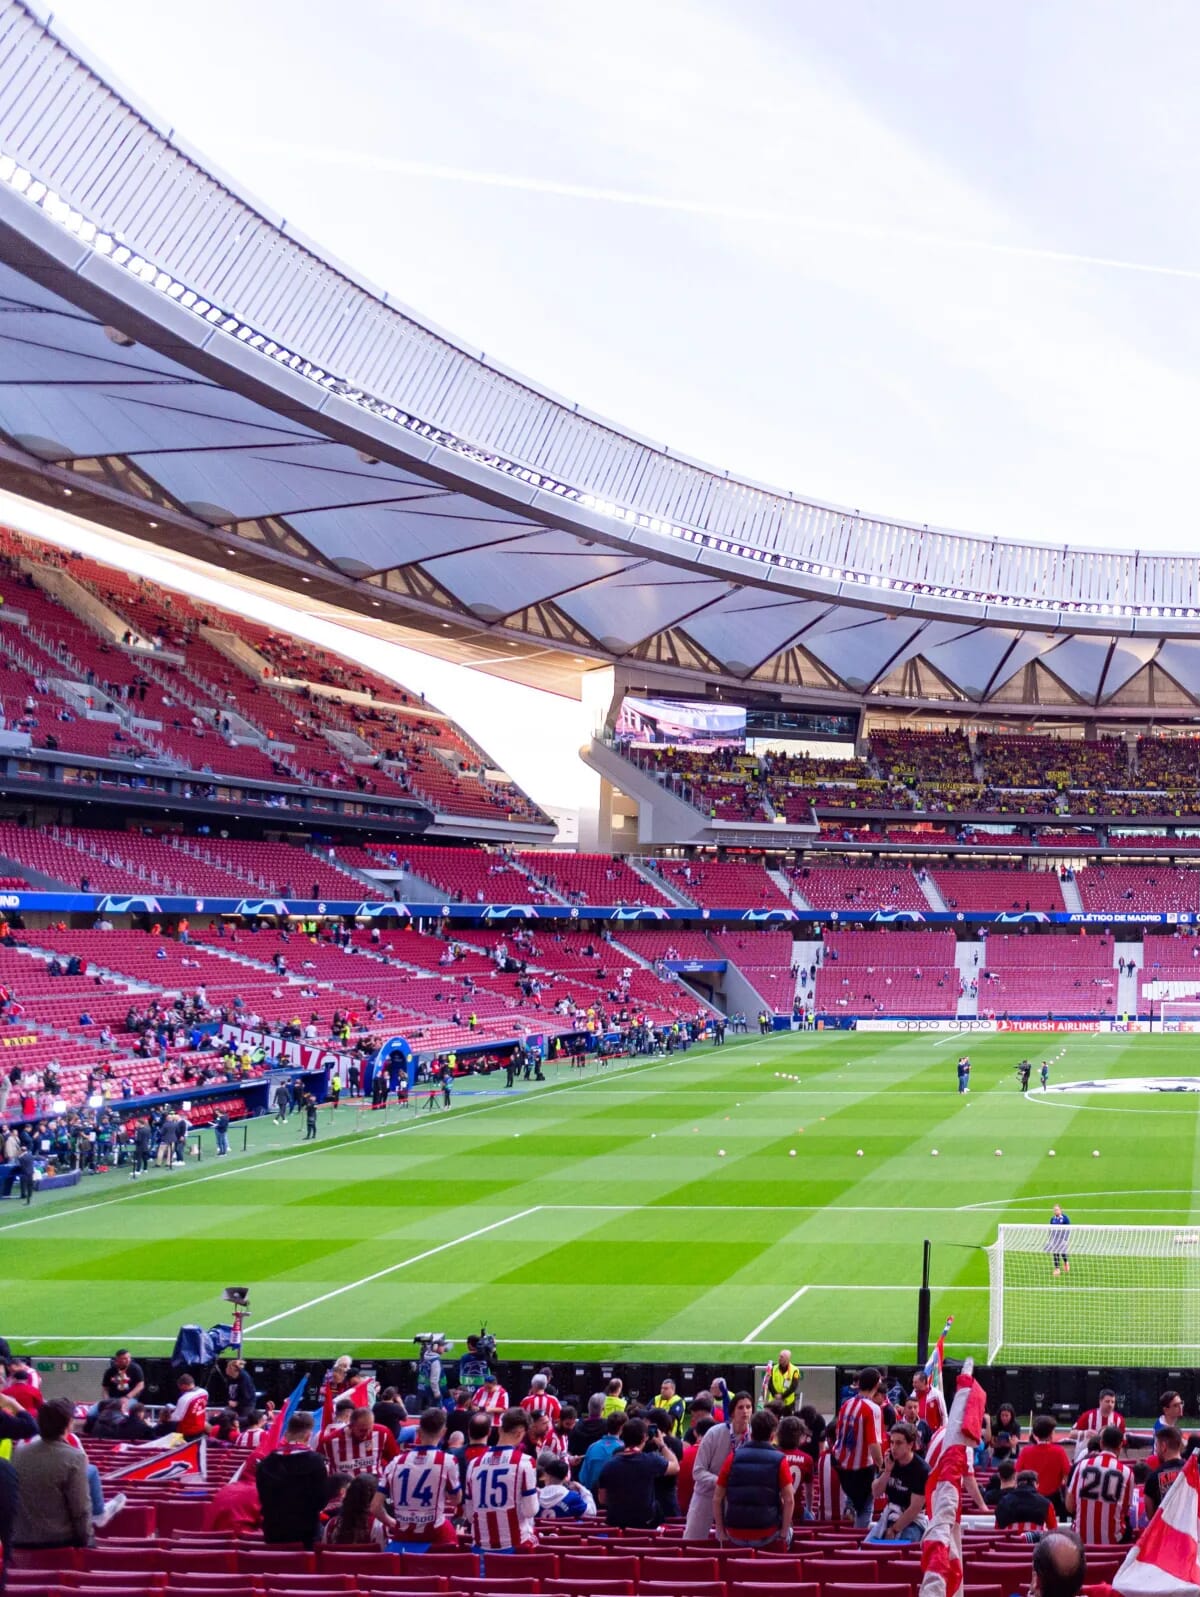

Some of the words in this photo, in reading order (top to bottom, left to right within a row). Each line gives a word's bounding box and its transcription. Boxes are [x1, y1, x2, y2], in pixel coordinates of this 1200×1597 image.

[1070, 912, 1113, 922] ATLÉTICO
[1114, 914, 1126, 922] DE
[1127, 914, 1161, 922] MADRID
[1180, 914, 1189, 922] 0
[1013, 1021, 1055, 1032] TURKISH
[1058, 1021, 1100, 1032] AIRLINES
[1110, 1022, 1143, 1032] FedEx
[398, 1468, 433, 1507] 14
[476, 1468, 509, 1508] 15
[1079, 1467, 1124, 1502] 20
